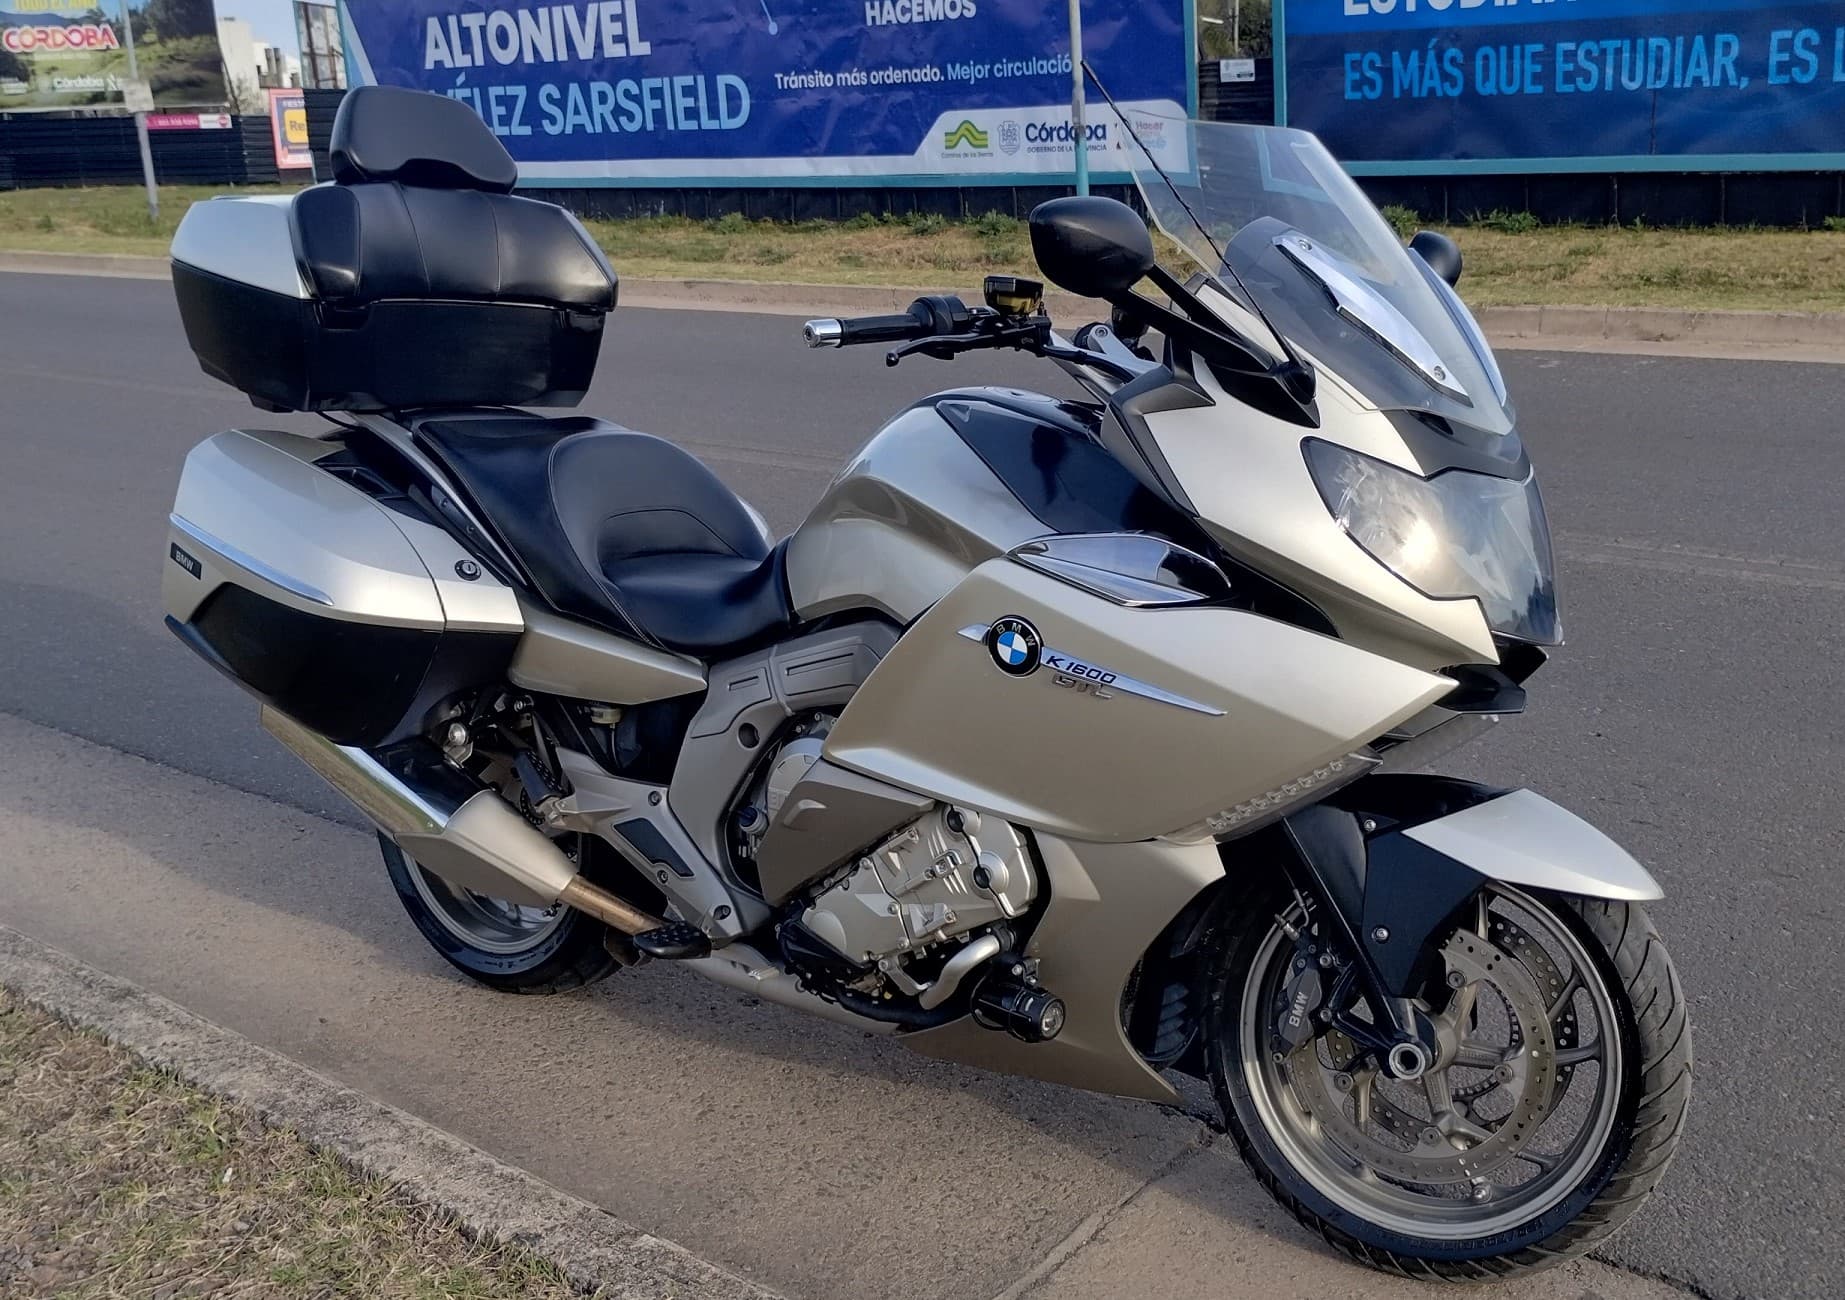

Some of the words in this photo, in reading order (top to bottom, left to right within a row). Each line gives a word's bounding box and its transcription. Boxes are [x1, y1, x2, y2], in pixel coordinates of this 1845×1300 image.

[865, 0, 977, 26] HACEMOS
[425, 0, 651, 69] ALTONIVEL
[774, 70, 834, 91] Tránsito
[837, 68, 867, 87] más
[870, 64, 944, 85] ordenado.
[947, 60, 991, 85] Mejor
[994, 53, 1073, 78] circulació
[1344, 52, 1383, 100] ES
[1392, 38, 1464, 98] MÁS
[1475, 44, 1544, 96] QUE
[1555, 33, 1749, 94] ESTUDIAR,
[1768, 28, 1820, 85] ES
[429, 72, 532, 136] LEZ
[541, 73, 751, 136] SARSFIELD
[175, 550, 194, 571] BMW
[995, 622, 1036, 647] BMW
[1046, 655, 1065, 668] K
[1066, 662, 1117, 684] 1600
[1289, 991, 1309, 1027] BMW
